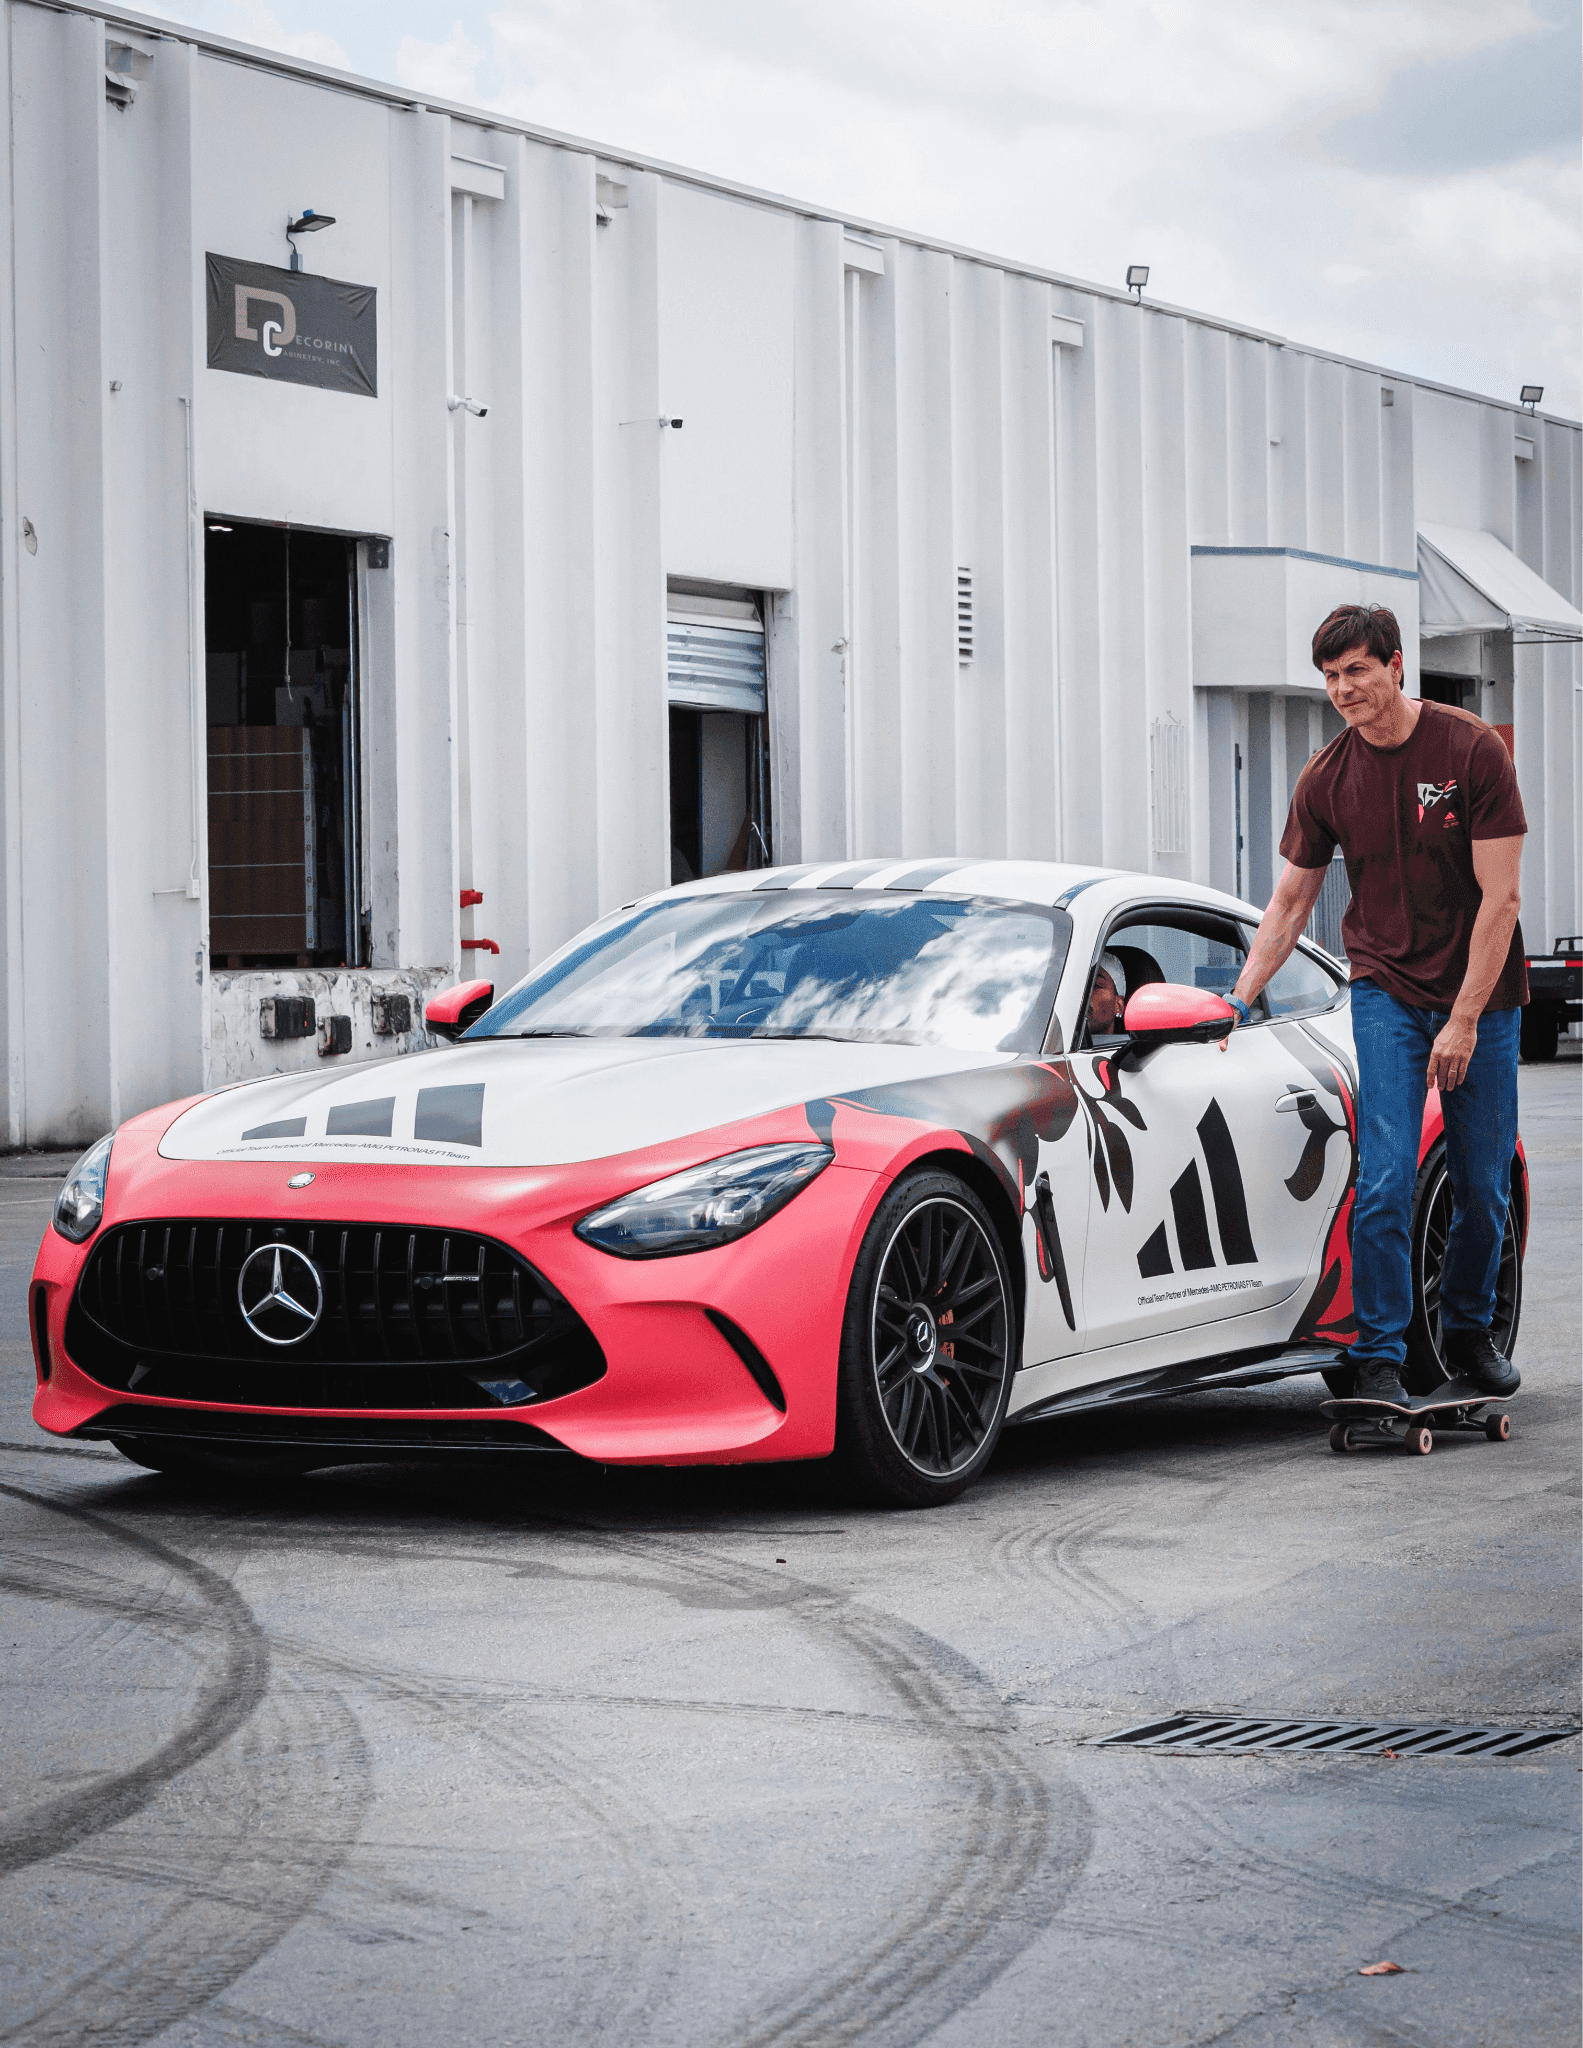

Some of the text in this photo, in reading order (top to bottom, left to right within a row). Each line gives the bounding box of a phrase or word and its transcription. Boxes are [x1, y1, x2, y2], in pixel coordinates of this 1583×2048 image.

[311, 1142, 384, 1150] Mercedes-AMG
[382, 1145, 436, 1155] PETRONAS
[445, 1151, 471, 1160] Team
[1137, 1295, 1154, 1305] Official
[1152, 1293, 1167, 1302] Team
[1165, 1291, 1182, 1300] Partner
[1181, 1288, 1187, 1298] of
[1186, 1283, 1222, 1296] Mercedes-AMG
[1221, 1280, 1247, 1291] PETRONAS
[1251, 1279, 1264, 1288] Team
